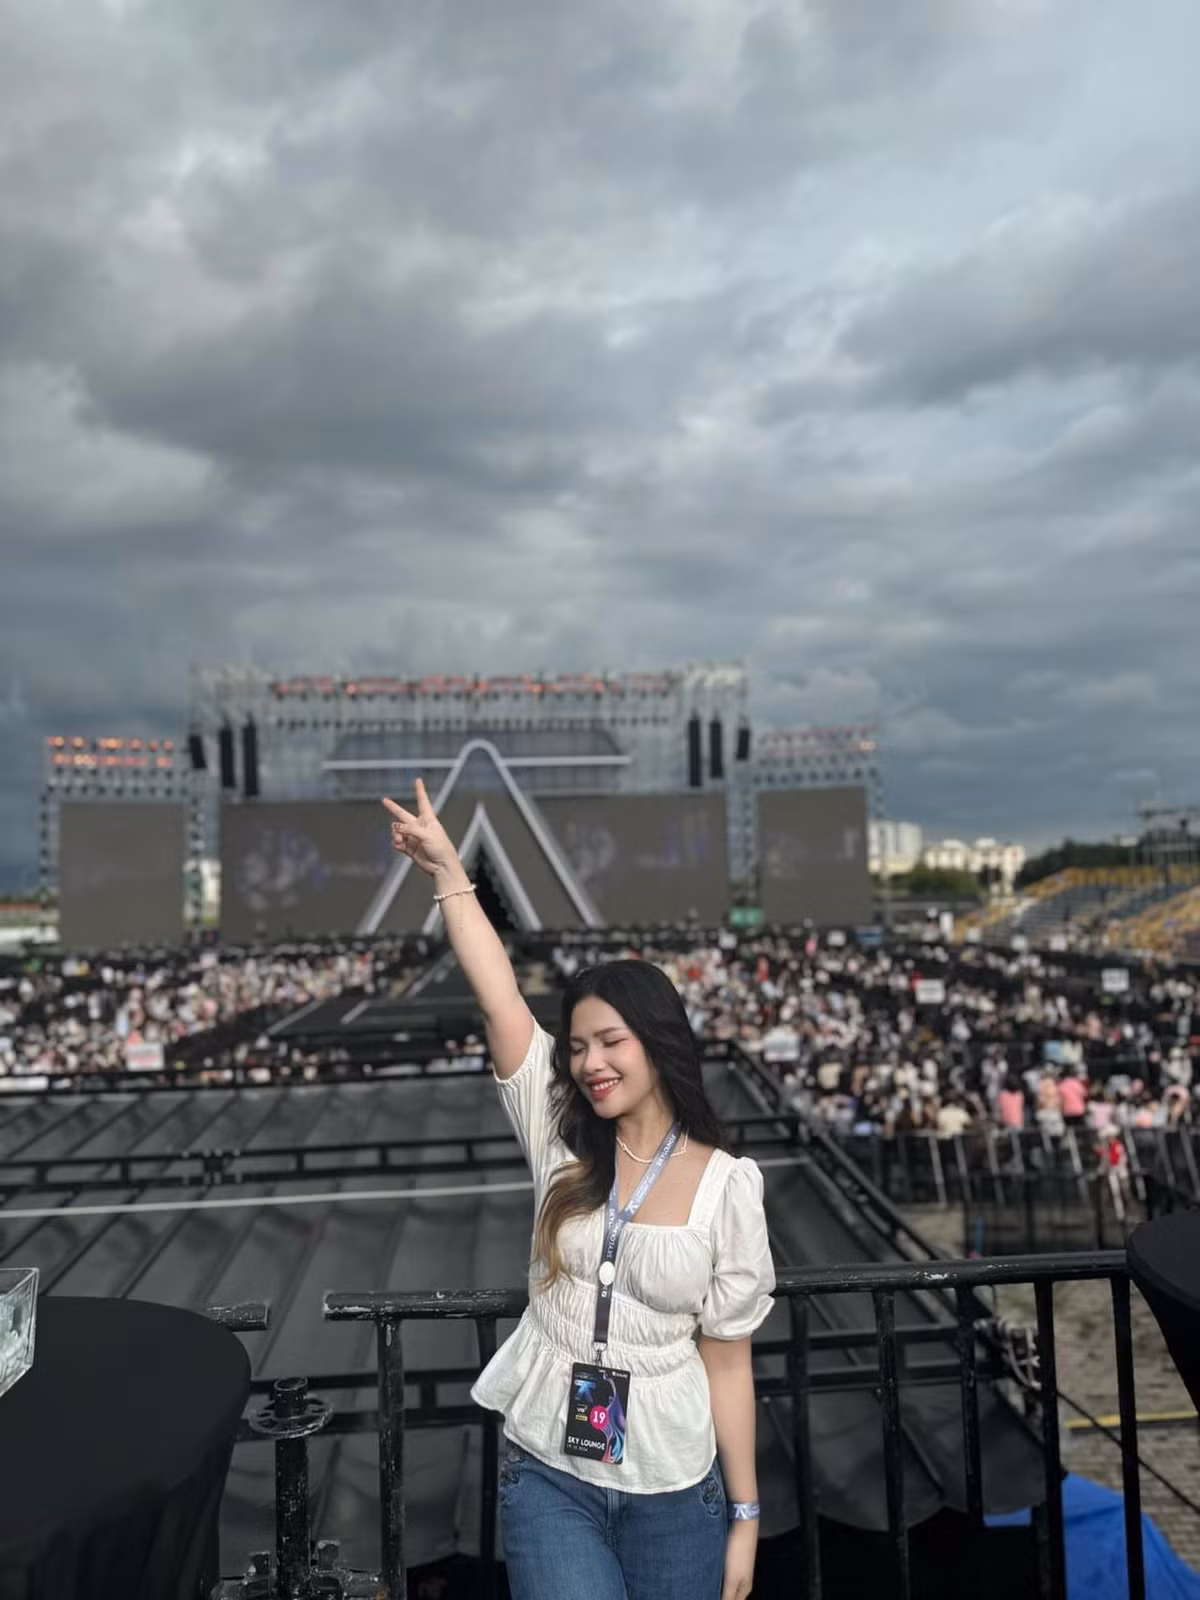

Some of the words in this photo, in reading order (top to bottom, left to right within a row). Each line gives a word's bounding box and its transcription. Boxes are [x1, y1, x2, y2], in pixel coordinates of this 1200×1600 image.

[593, 1411, 606, 1424] 19
[568, 1436, 579, 1444] SKY
[581, 1438, 605, 1450] LOUNGE
